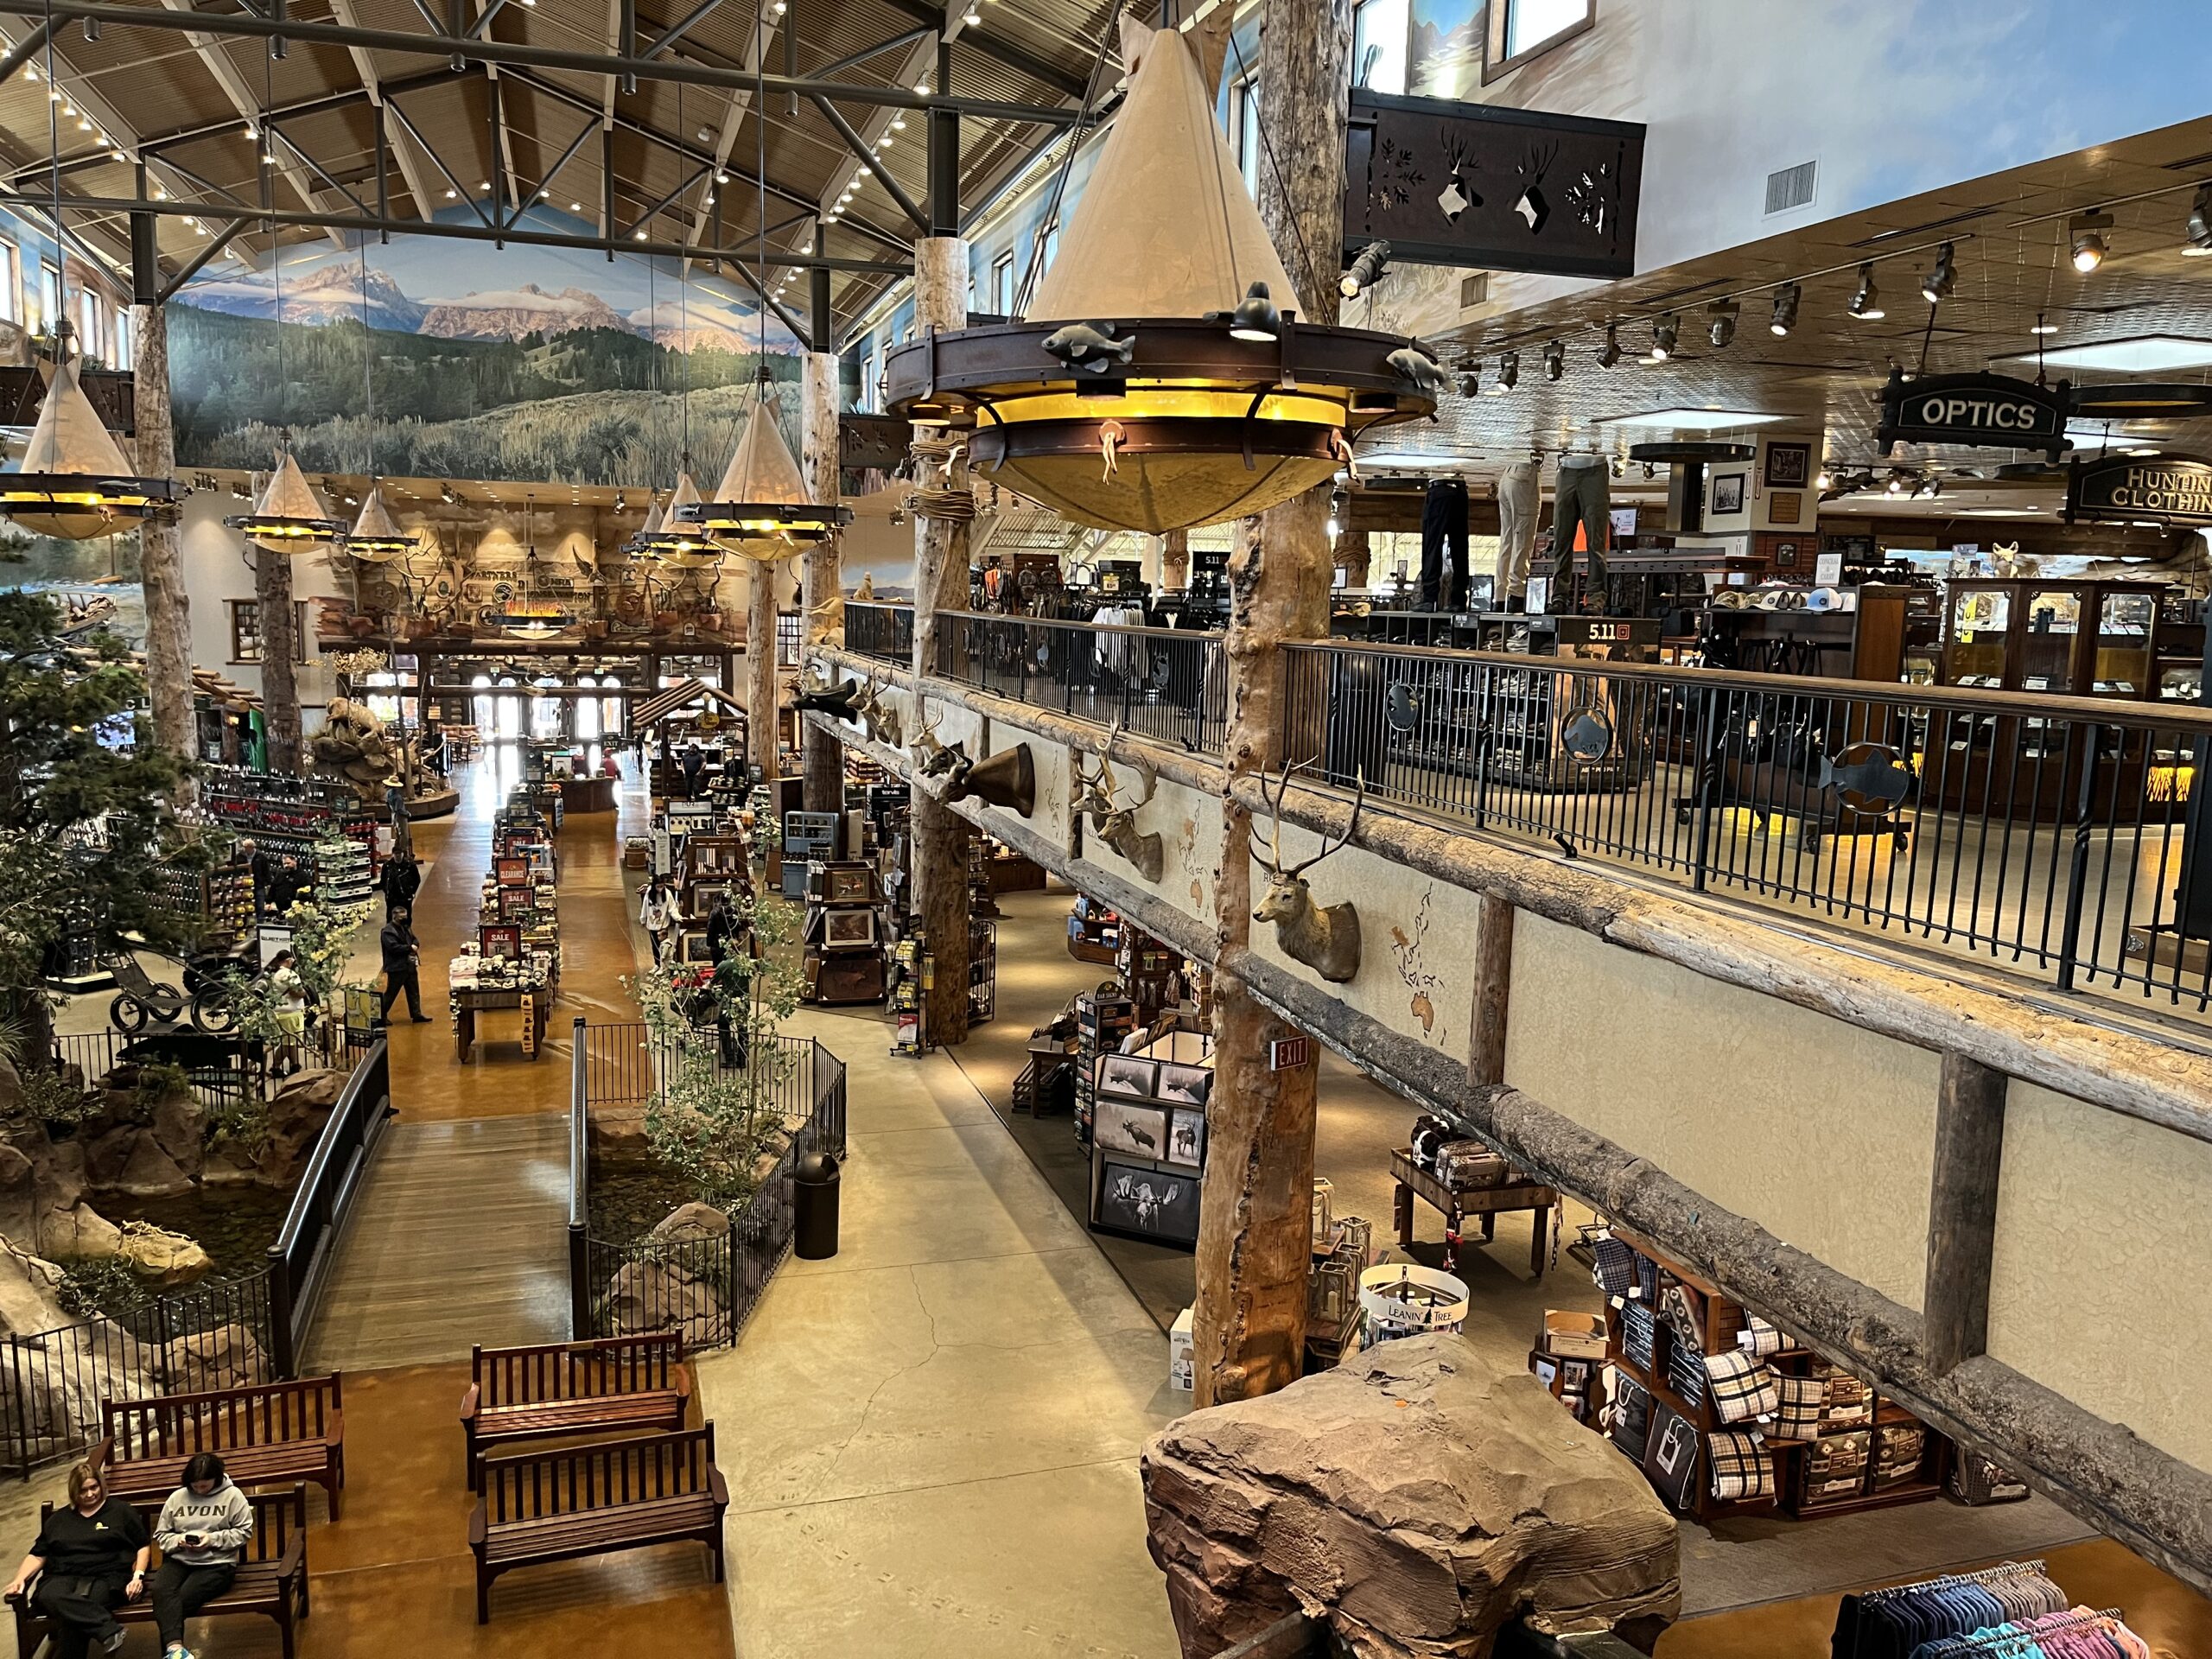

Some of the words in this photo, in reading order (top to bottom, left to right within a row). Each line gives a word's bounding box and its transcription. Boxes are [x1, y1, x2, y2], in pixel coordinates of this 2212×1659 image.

[1923, 397, 2037, 429] OPTICS
[1205, 556, 1219, 564] 5.11
[1589, 624, 1616, 640] 5.11
[500, 869, 524, 879] CLEARANCE
[1279, 1040, 1303, 1066] EXIT
[1434, 1311, 1452, 1322] TREE
[173, 1505, 227, 1517] AVON
